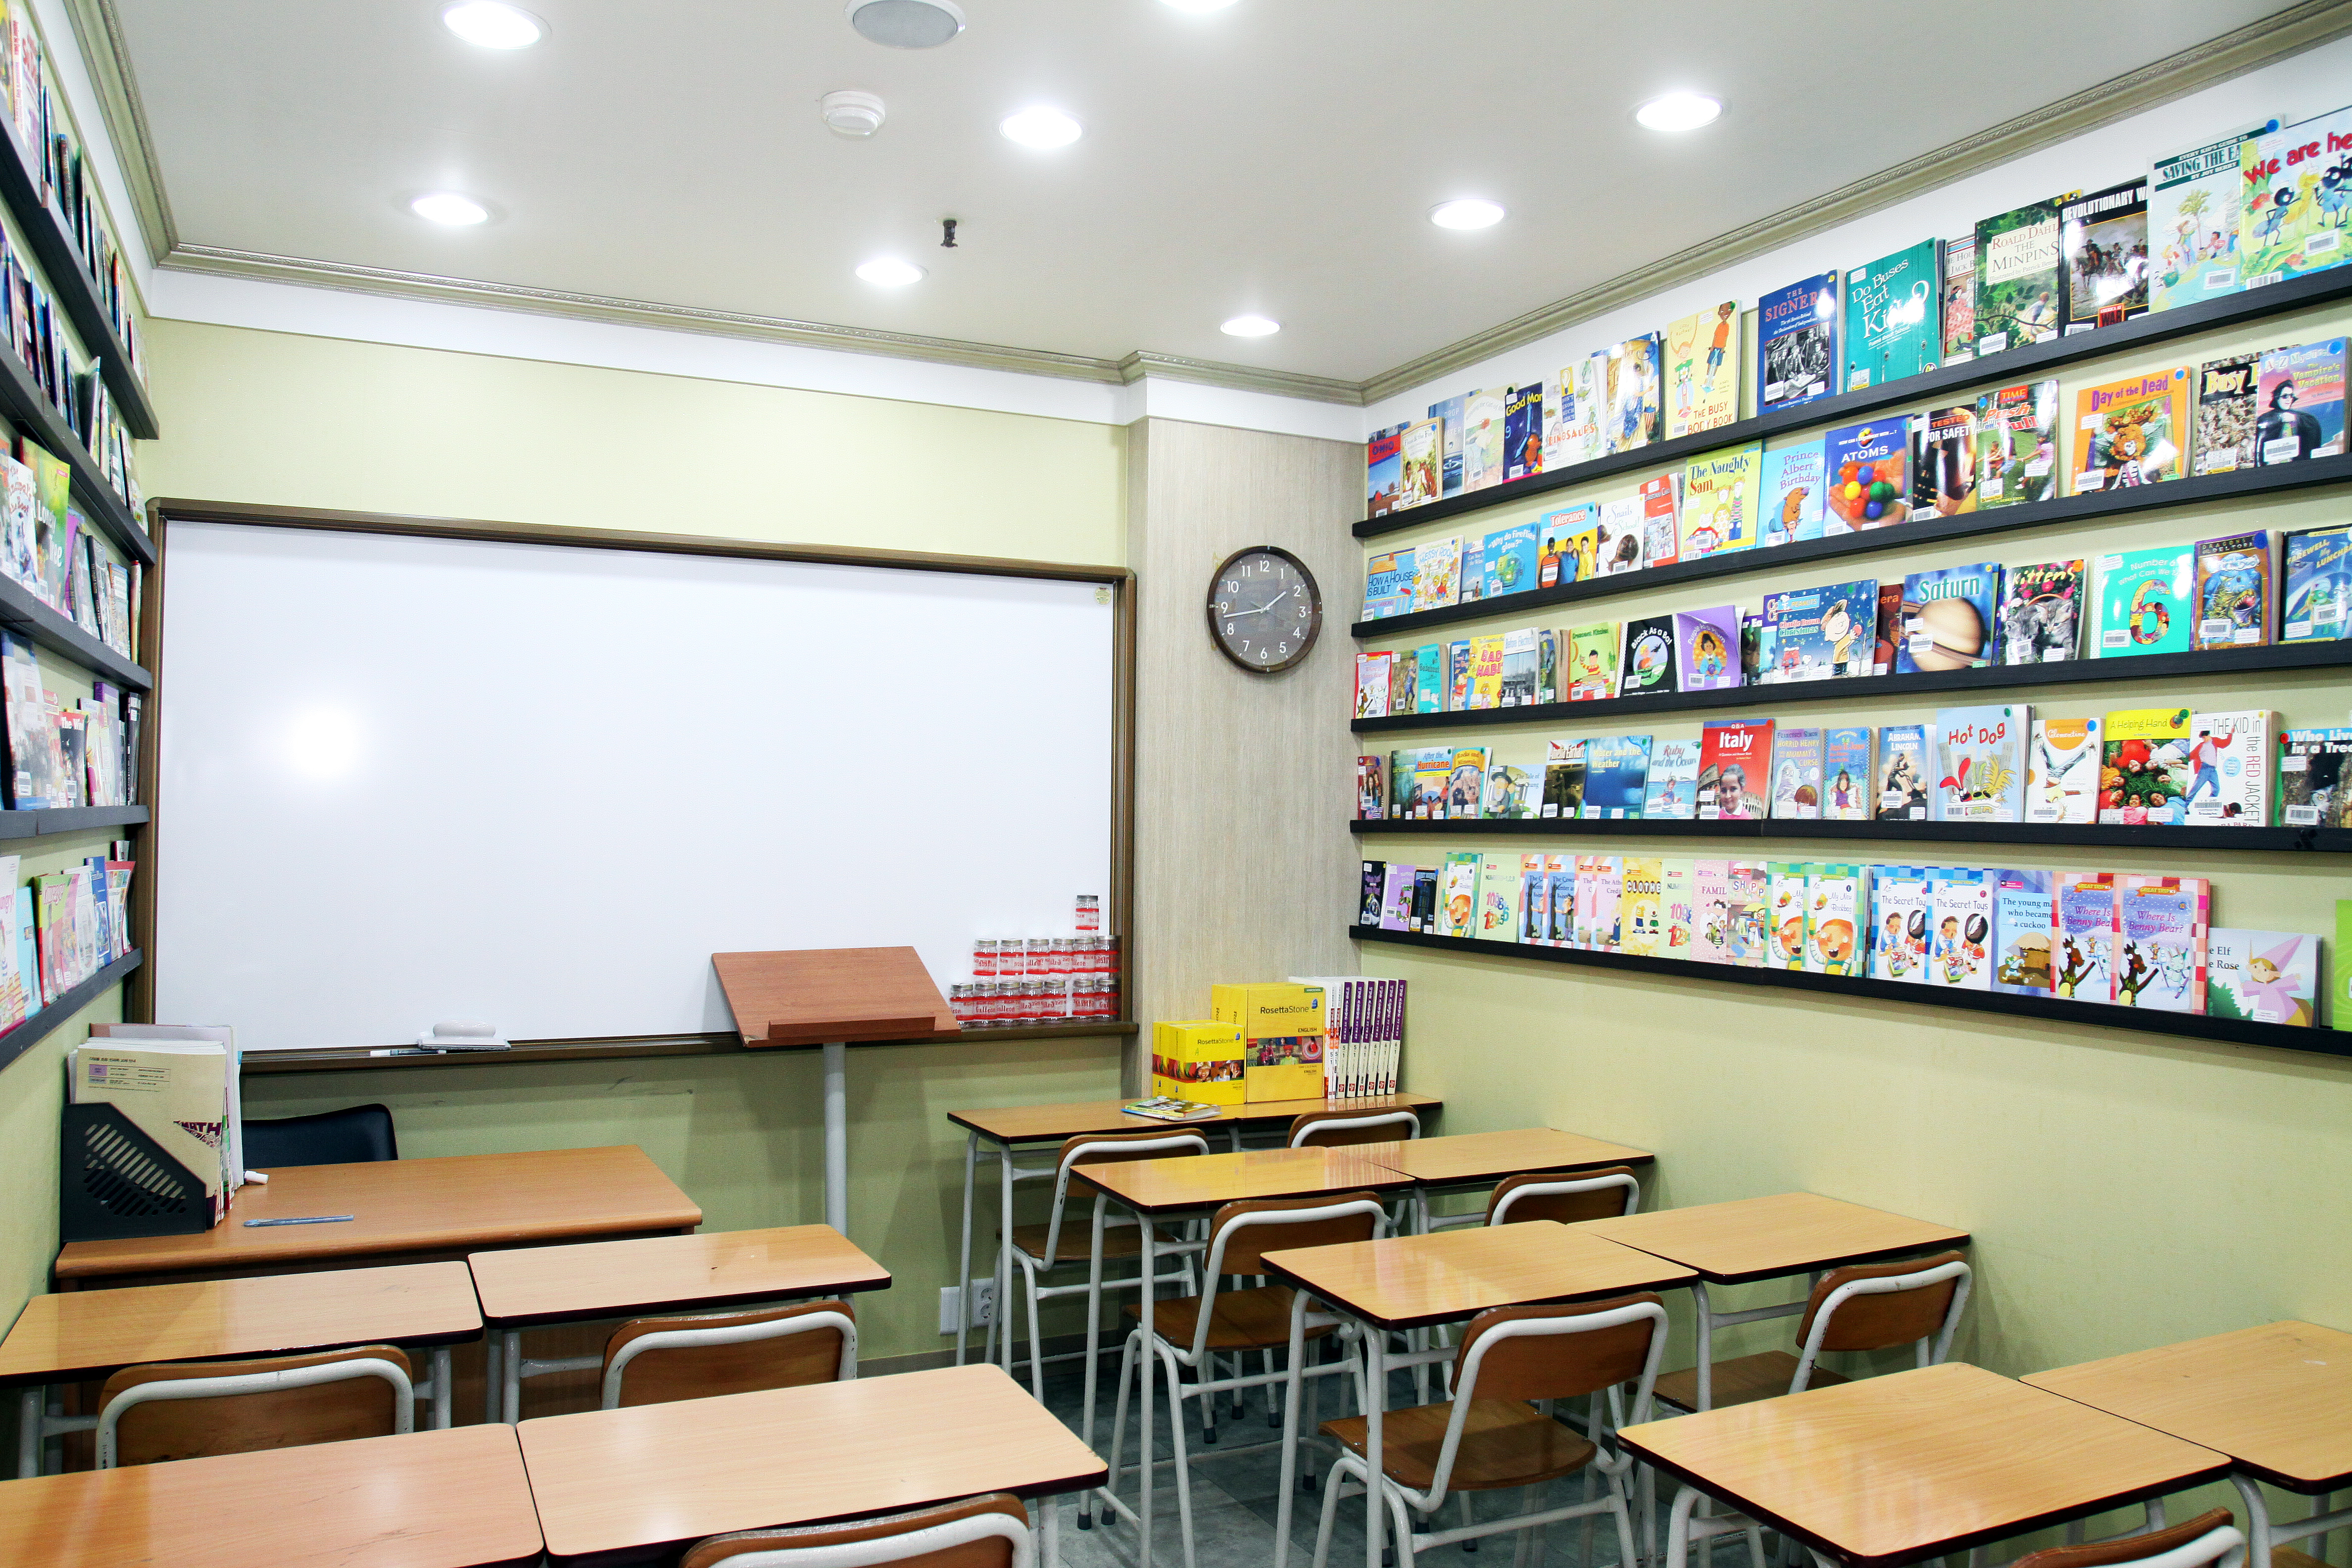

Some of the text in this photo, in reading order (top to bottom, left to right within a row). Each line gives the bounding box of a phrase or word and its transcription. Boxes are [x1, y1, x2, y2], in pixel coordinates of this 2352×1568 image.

[2162, 149, 2225, 182] SAVING THE
[2243, 141, 2320, 184] We are
[2062, 189, 2134, 223] REVOLUTIONARY
[1992, 224, 2058, 249] ROALD DAHL
[2015, 240, 2035, 253] THE
[1993, 241, 2058, 273] MINPINS
[1950, 263, 1966, 275] JACK
[1852, 259, 1910, 303] Do Buses
[1787, 288, 1803, 299] THE
[1862, 287, 1890, 314] Eat
[2292, 363, 2341, 381] Vampire's
[2205, 368, 2248, 396] Busy
[2297, 374, 2340, 388] Vacation
[2001, 389, 2026, 399] TIME
[2091, 374, 2168, 411] Day of the Dead
[1506, 396, 1525, 417] Good
[1693, 400, 1728, 420] THE BUSY
[1982, 401, 2031, 423] Push
[1688, 413, 1733, 436] BODY BOOK
[1931, 414, 1970, 428] TESTED
[1548, 423, 1596, 446] DINOSAURS
[1927, 424, 1977, 442] FOR SAFETY
[1783, 451, 1819, 465] Prince
[1841, 445, 1889, 463] ATOMS
[1690, 454, 1751, 480] The Naughty
[1690, 478, 1713, 497] Sam
[1780, 472, 1821, 490] Birthday
[1550, 509, 1586, 528] Tolerance
[1607, 504, 1633, 524] Snails
[1504, 529, 1536, 540] do fireflies
[1241, 565, 1251, 577] 11
[1260, 560, 1270, 573] 12
[2130, 559, 2168, 571] Number
[1368, 574, 1384, 587] HOW
[1390, 570, 1413, 583] HOUSE
[2012, 566, 2077, 586] Kittens
[1227, 581, 1239, 593] 10
[1293, 585, 1301, 597] 2
[1372, 585, 1390, 596] BUILT
[1919, 576, 1980, 602] Saturn
[1221, 601, 1228, 614] 9
[1299, 606, 1306, 618] 3
[2130, 579, 2170, 644] 6
[1226, 623, 1234, 635] 8
[1779, 618, 1820, 629] Charlie Brown
[1293, 626, 1301, 638] 4
[1631, 630, 1649, 649] Black
[1649, 627, 1657, 635] As
[1663, 631, 1672, 645] Bat
[1779, 626, 1819, 637] Christmas
[1242, 639, 1250, 652] 7
[1279, 641, 1287, 653] 5
[1260, 647, 1268, 659] 6
[1480, 650, 1503, 662] BAD
[2117, 719, 2144, 731] Helping
[2146, 718, 2167, 728] Hand
[2213, 716, 2260, 735] THE KID in
[1948, 722, 2005, 745] Hot Dog
[2048, 729, 2085, 739] Clementine
[2292, 730, 2325, 742] Who
[1719, 730, 1754, 752] Italy
[1891, 742, 1918, 751] LINCOLN
[1593, 748, 1613, 757] Water
[1630, 746, 1642, 756] the
[1664, 744, 1685, 756] Ruby
[2292, 742, 2320, 754] in a
[1417, 760, 1450, 770] Hurricane
[1592, 760, 1620, 768] Weather
[1652, 758, 1663, 766] and
[1676, 756, 1697, 767] Ocean
[1799, 758, 1819, 767] CURSE
[2246, 755, 2260, 777] RED
[2244, 781, 2260, 823] JACKET
[1882, 895, 1892, 904] The
[1894, 896, 1913, 905] Secret
[1936, 898, 1989, 912] The Secret Toys
[2002, 897, 2042, 908] The young
[2025, 910, 2052, 919] became
[2075, 905, 2110, 916] Where Is
[2137, 910, 2176, 922] Where Is
[2020, 921, 2046, 929] cuckoo
[2067, 916, 2093, 927] Benny
[2129, 921, 2184, 934] Benny Bear?
[2217, 946, 2231, 956] Elf
[2216, 960, 2240, 970] Rose
[1260, 1005, 1309, 1015] RosettaStone
[1197, 1037, 1234, 1045] RosettaStone
